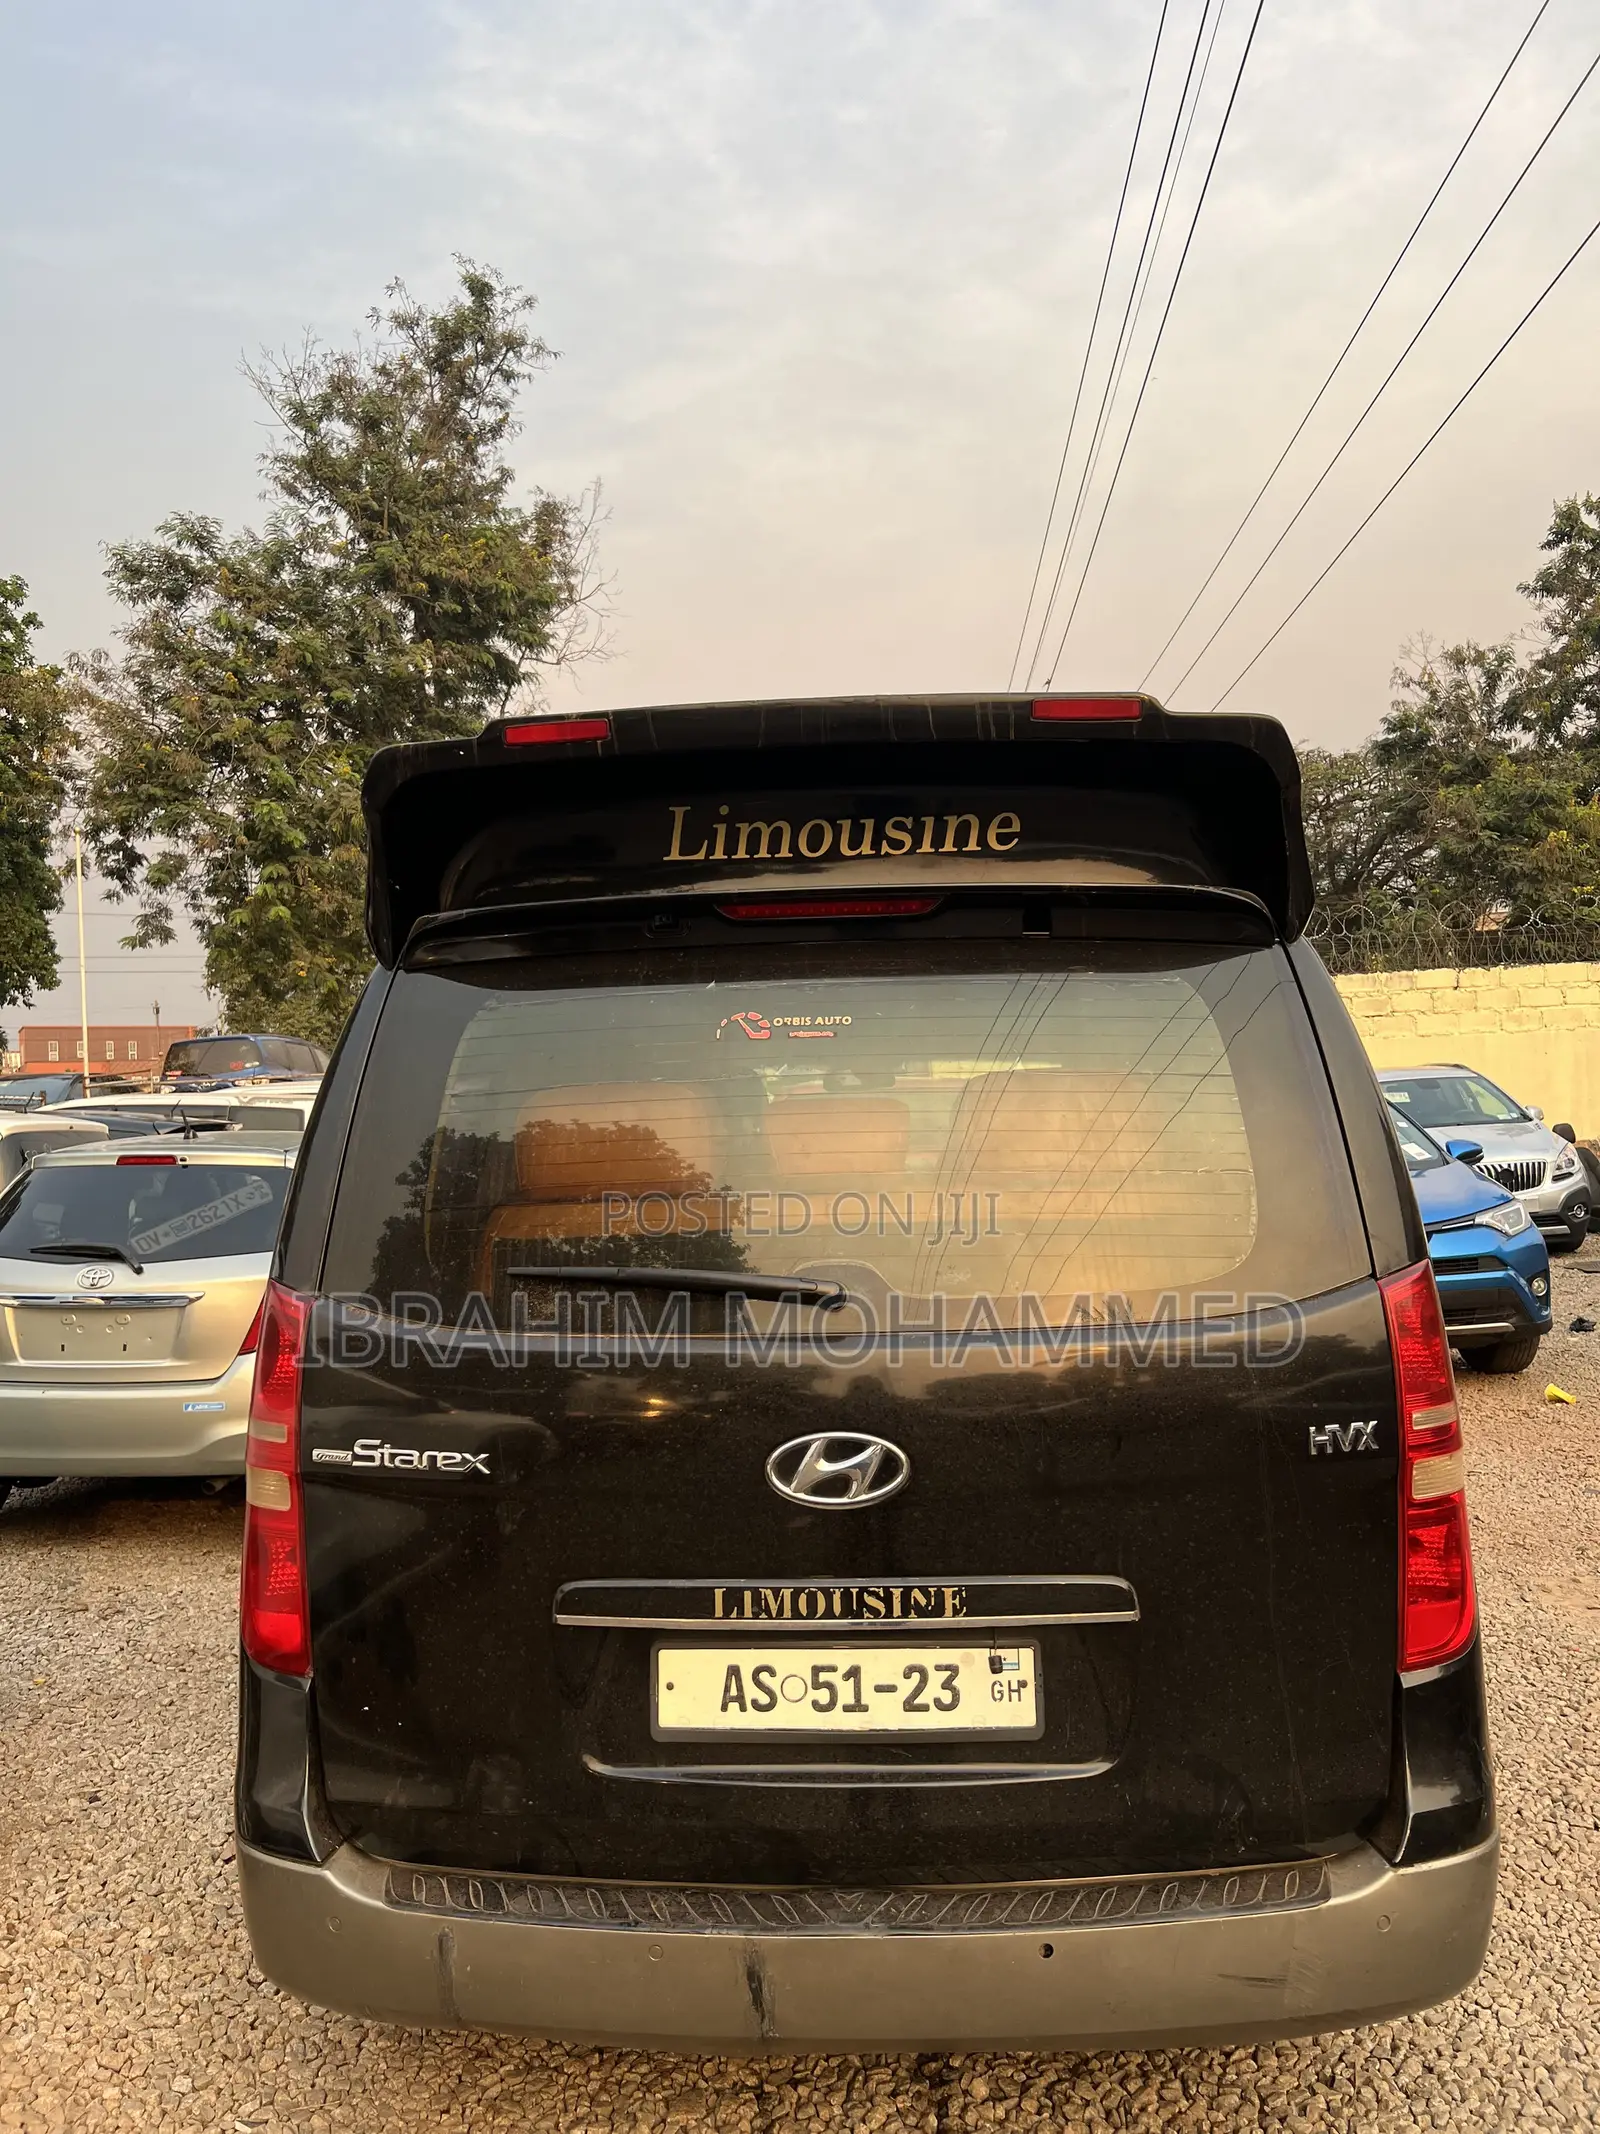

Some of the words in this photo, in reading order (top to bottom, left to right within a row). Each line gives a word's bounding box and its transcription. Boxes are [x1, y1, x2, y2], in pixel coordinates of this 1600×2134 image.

[663, 805, 1021, 861] Limousine
[773, 1016, 811, 1027] ORBIS
[815, 1015, 852, 1025] AUTO
[314, 1451, 350, 1463] Grand
[352, 1438, 491, 1474] Starex
[1308, 1420, 1380, 1456] HVX
[713, 1586, 968, 1619] LIMOUSINE
[720, 1663, 778, 1713] AS
[811, 1662, 961, 1713] 51-23
[990, 1680, 1022, 1704] GH
